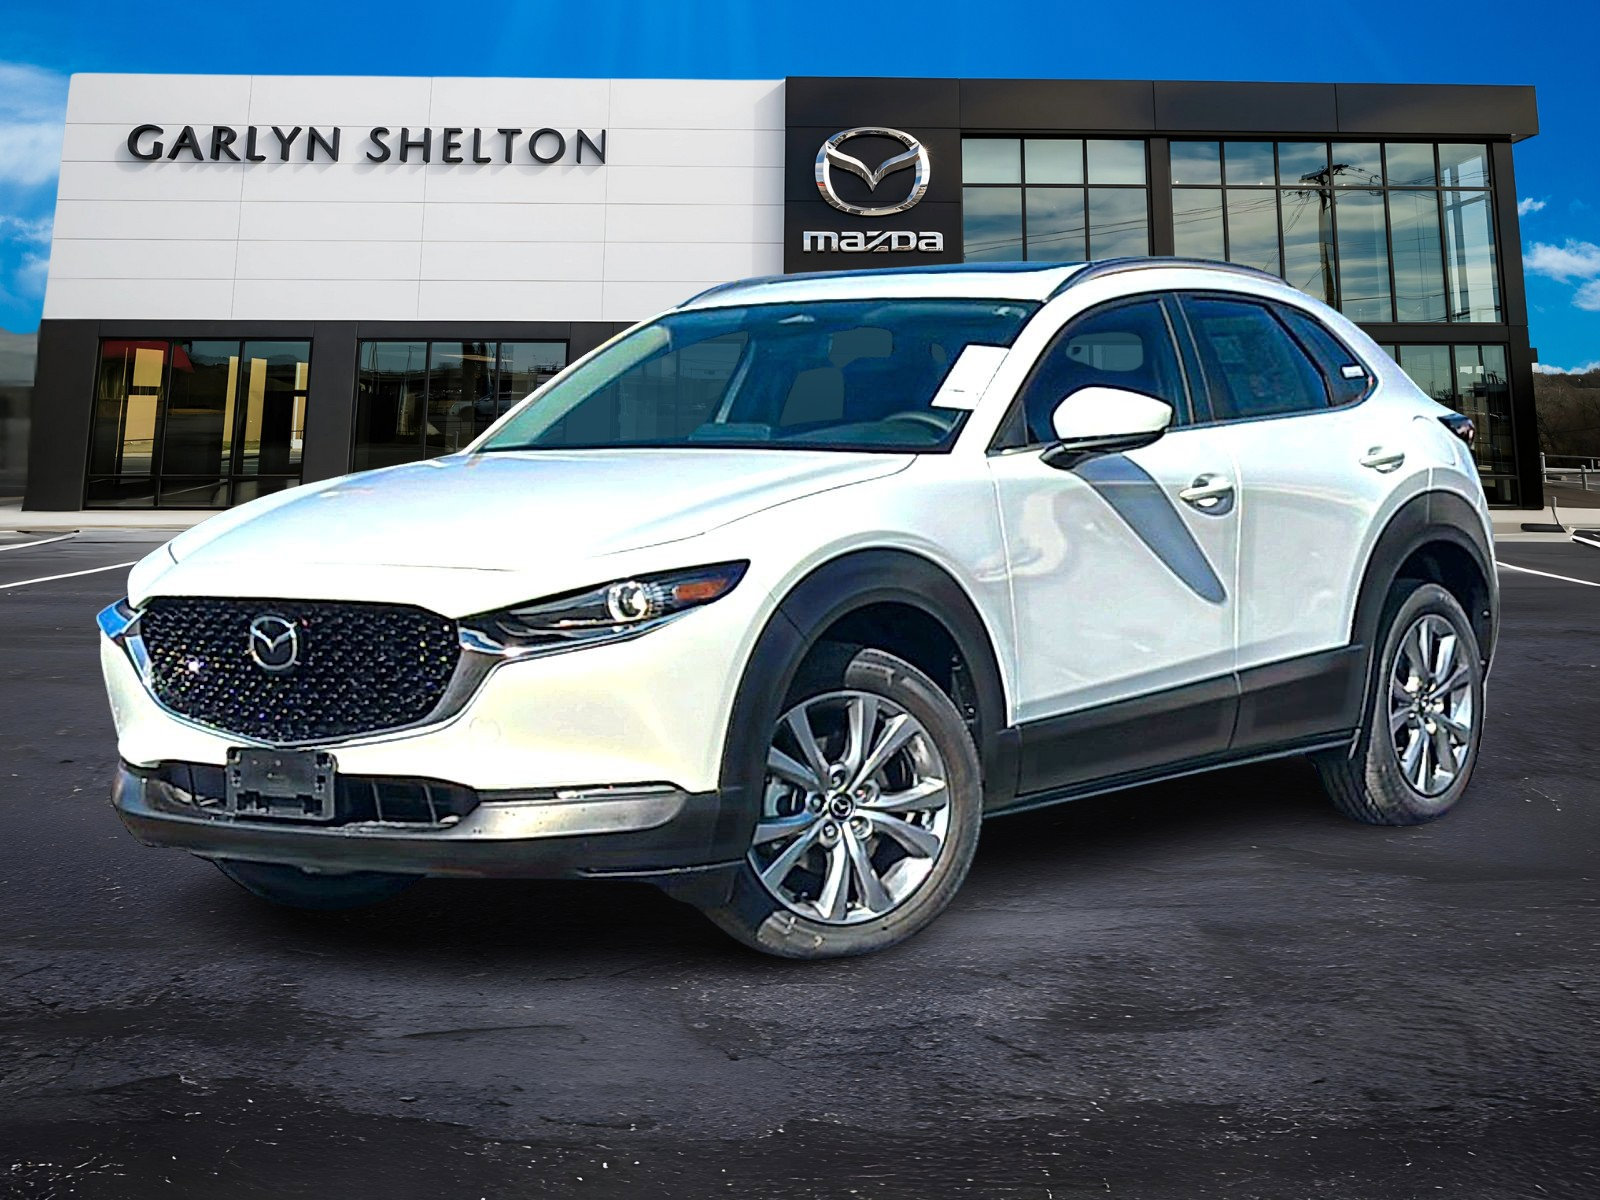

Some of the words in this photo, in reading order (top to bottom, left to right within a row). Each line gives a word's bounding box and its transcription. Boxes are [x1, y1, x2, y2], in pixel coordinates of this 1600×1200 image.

[127, 124, 341, 162] GARLYN
[366, 127, 606, 165] SHELTON
[803, 230, 944, 253] mazda
